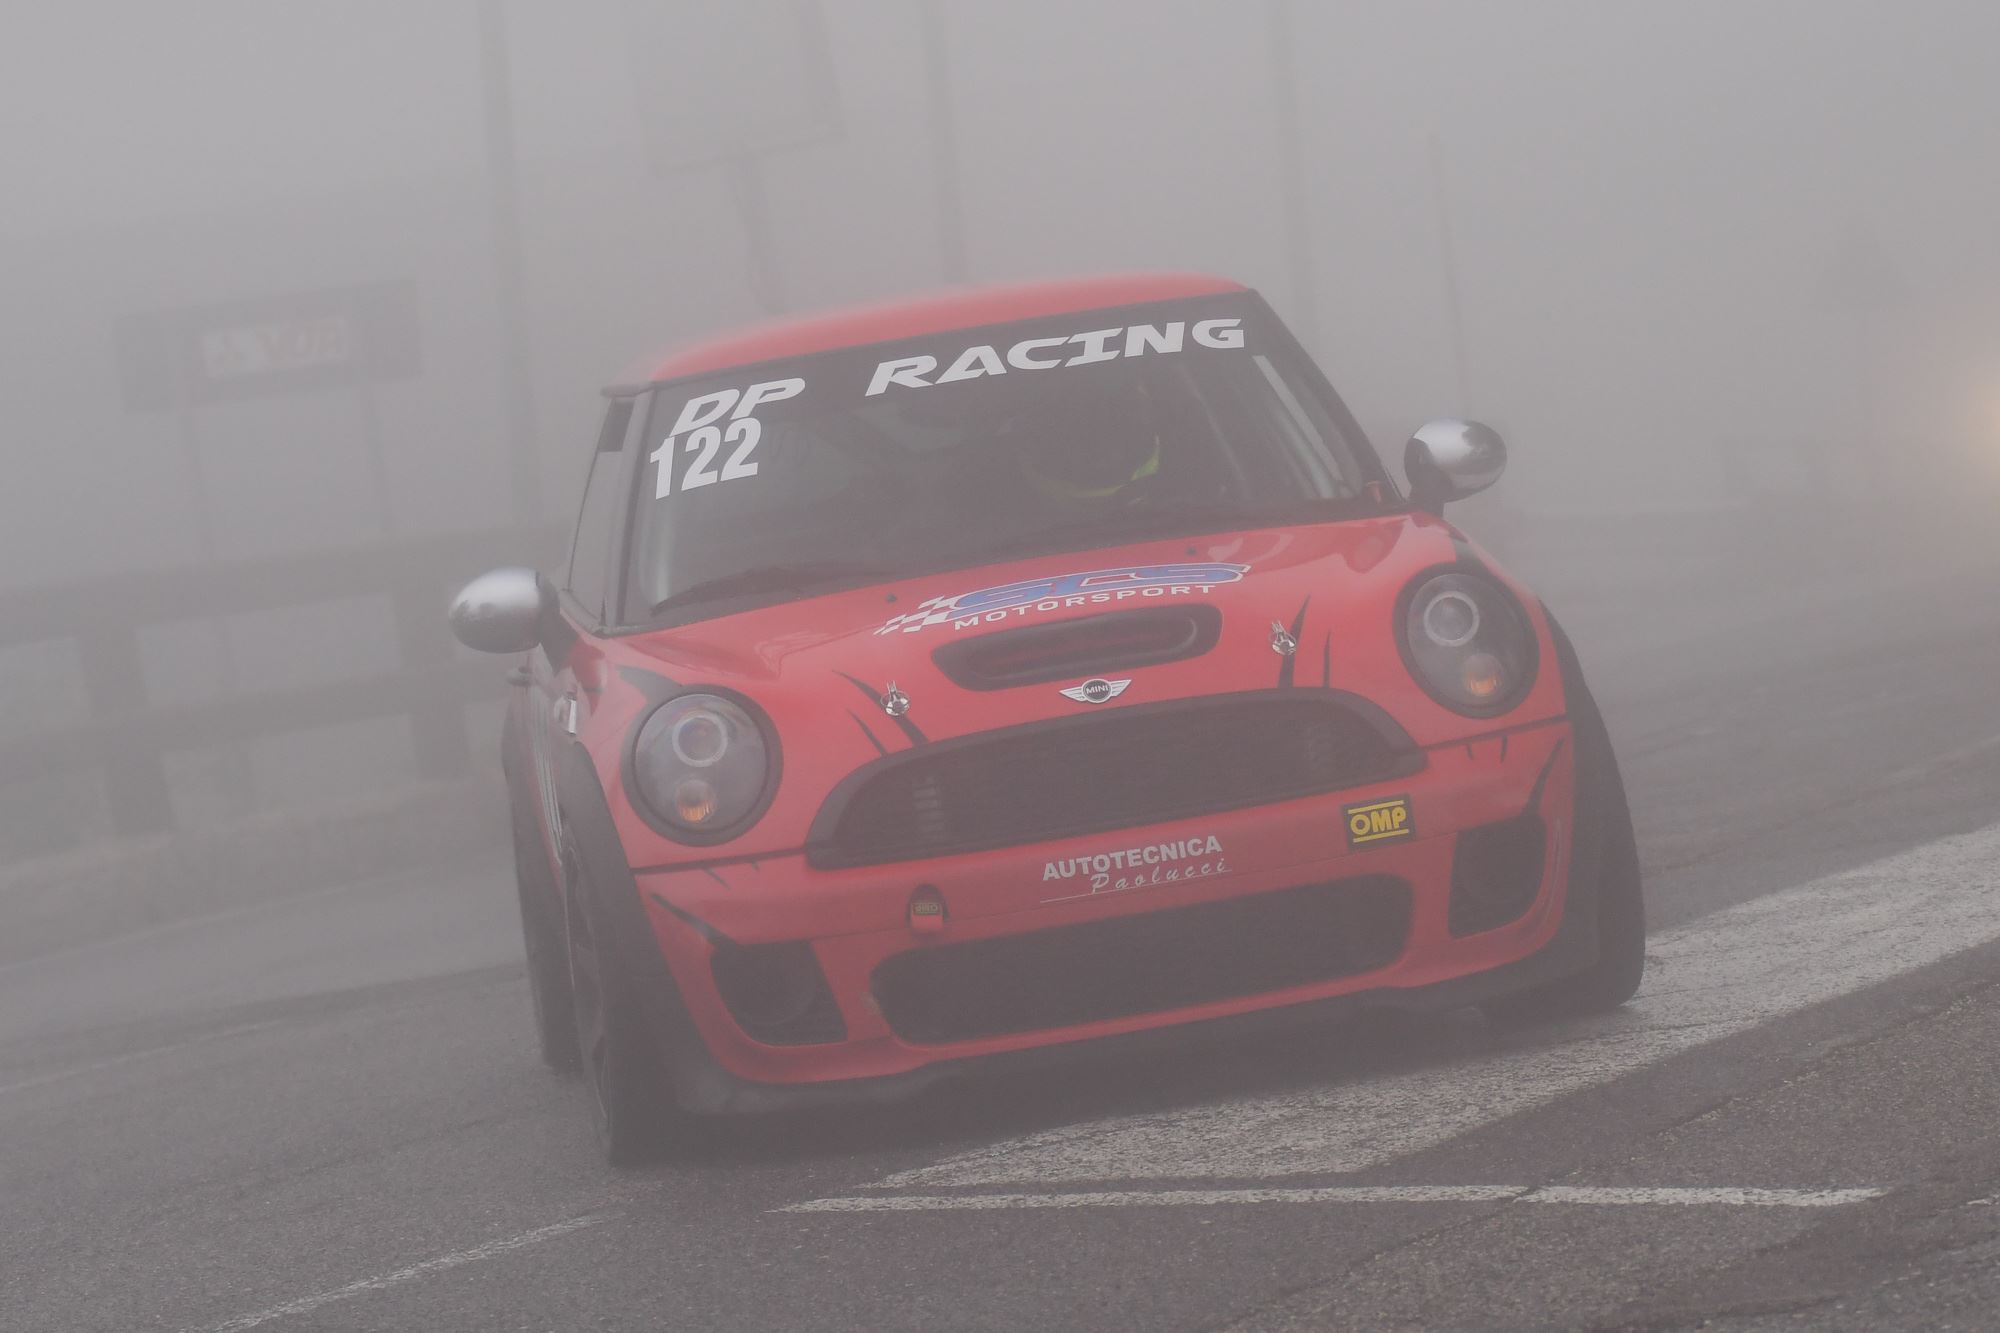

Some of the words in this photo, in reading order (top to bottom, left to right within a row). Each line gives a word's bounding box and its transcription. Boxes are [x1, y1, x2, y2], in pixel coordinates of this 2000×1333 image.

[669, 377, 806, 437] DP
[865, 318, 1245, 396] RACING
[649, 417, 762, 500] 122
[954, 584, 1217, 631] MOTORSPORT
[1085, 684, 1109, 694] MINI
[1350, 806, 1406, 836] OMP
[1042, 835, 1223, 881] AUTOTECNICA
[1090, 857, 1226, 895] Paolucci
